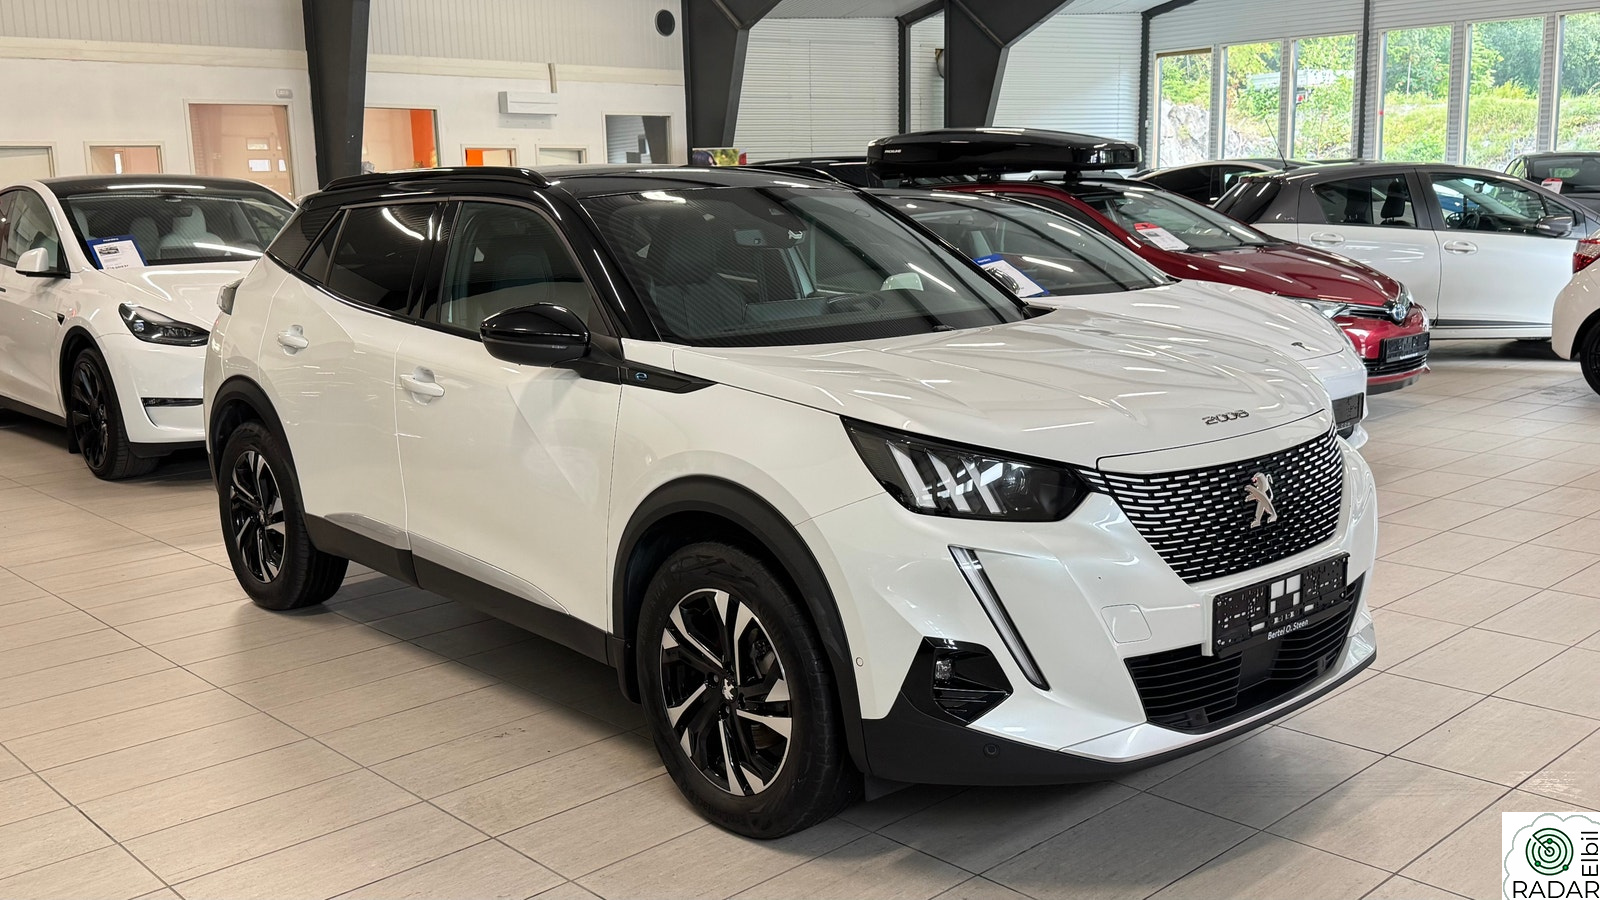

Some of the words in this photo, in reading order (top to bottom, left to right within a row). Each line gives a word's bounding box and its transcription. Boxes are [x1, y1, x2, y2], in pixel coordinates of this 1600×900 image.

[1201, 409, 1250, 425] 2008
[1267, 626, 1285, 640] Bertel
[1286, 624, 1293, 633] O.
[1293, 619, 1309, 631] Steen
